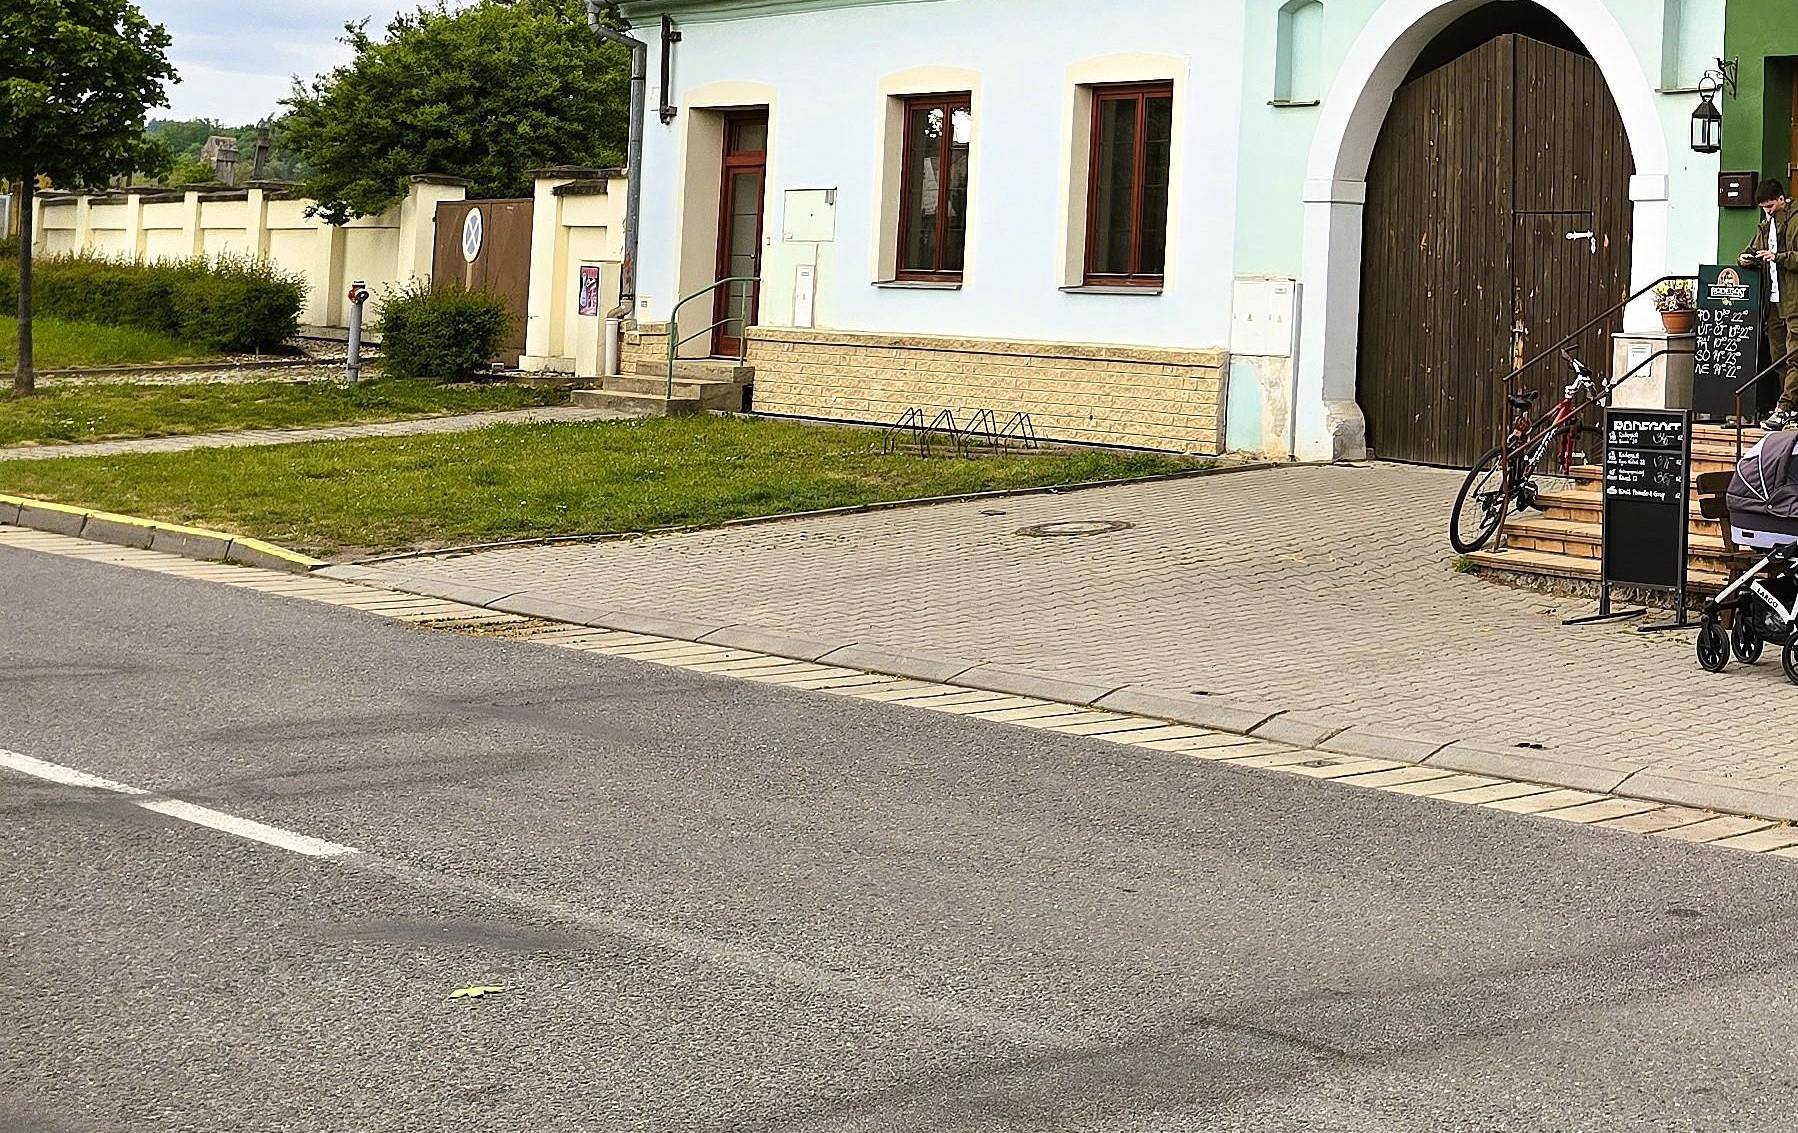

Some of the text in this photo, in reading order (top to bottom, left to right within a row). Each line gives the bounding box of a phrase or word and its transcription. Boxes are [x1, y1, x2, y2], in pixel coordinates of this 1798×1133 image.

[1697, 309, 1711, 322] PO
[1694, 349, 1711, 362] SO
[1695, 363, 1710, 375] NE
[1757, 588, 1779, 608] LARGO
